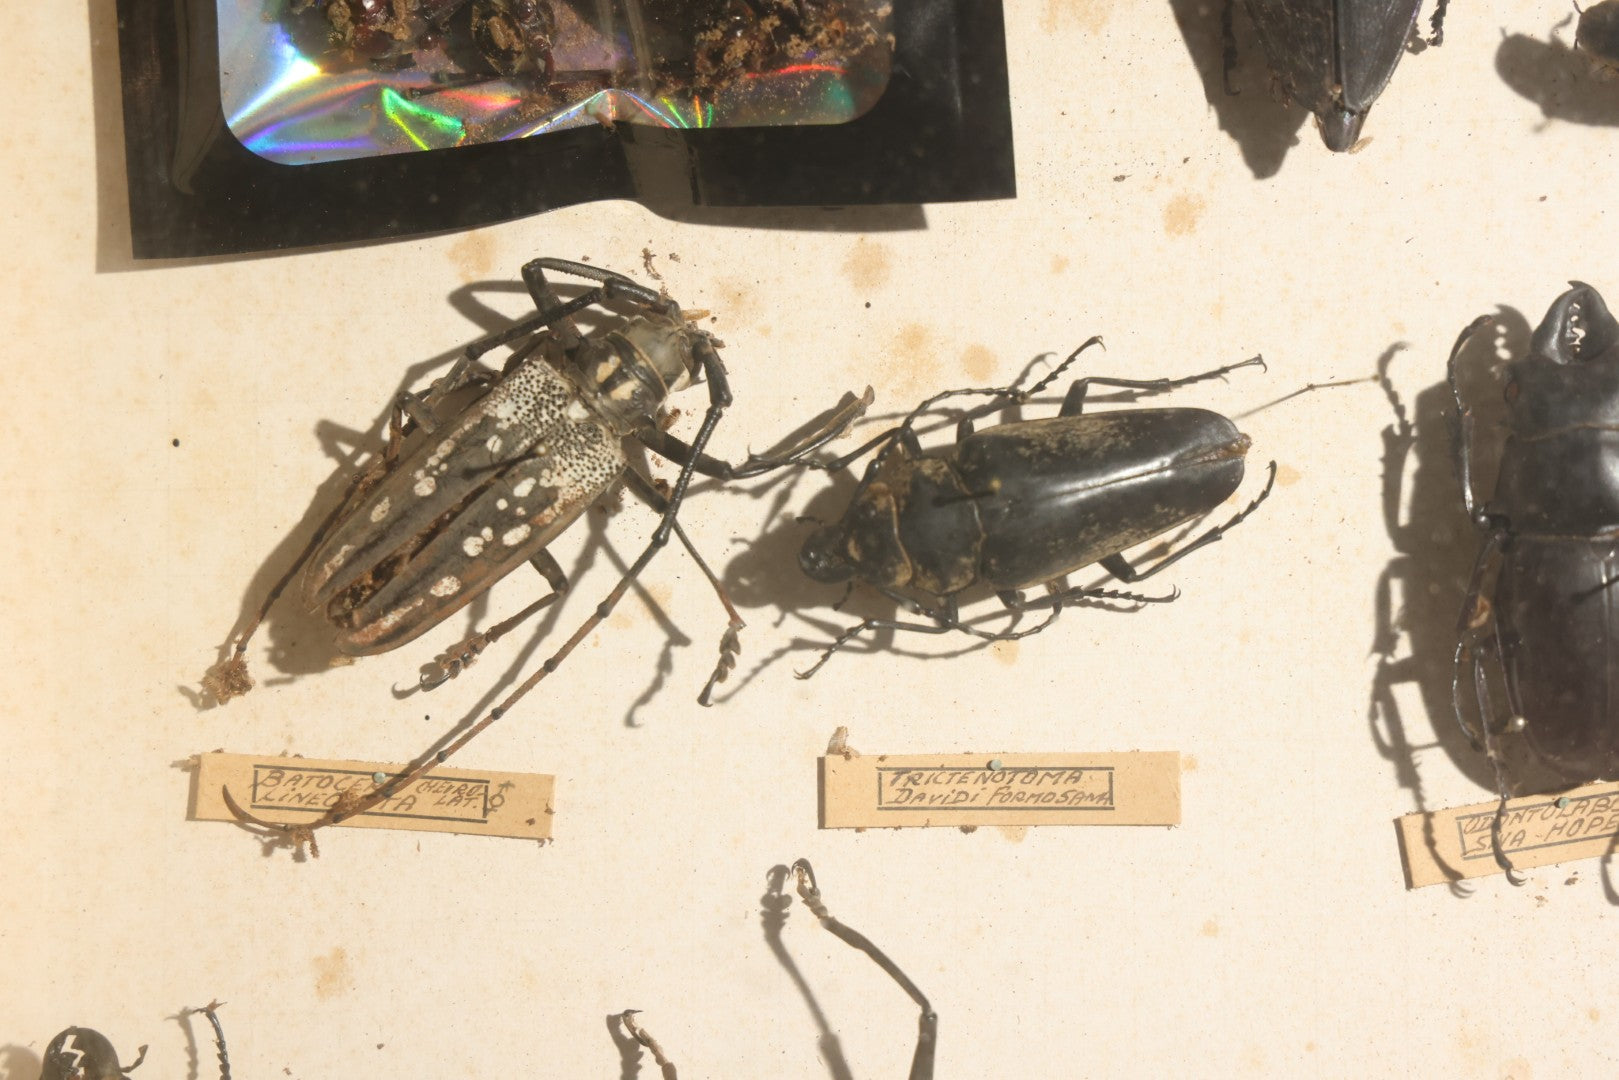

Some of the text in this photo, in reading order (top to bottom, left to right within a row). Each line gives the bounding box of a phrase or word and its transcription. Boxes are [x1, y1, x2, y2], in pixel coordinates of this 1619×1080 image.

[251, 769, 396, 796] BATOCER
[889, 769, 1084, 787] TRICTENOTOMA
[1464, 813, 1619, 856] SVA HOPE
